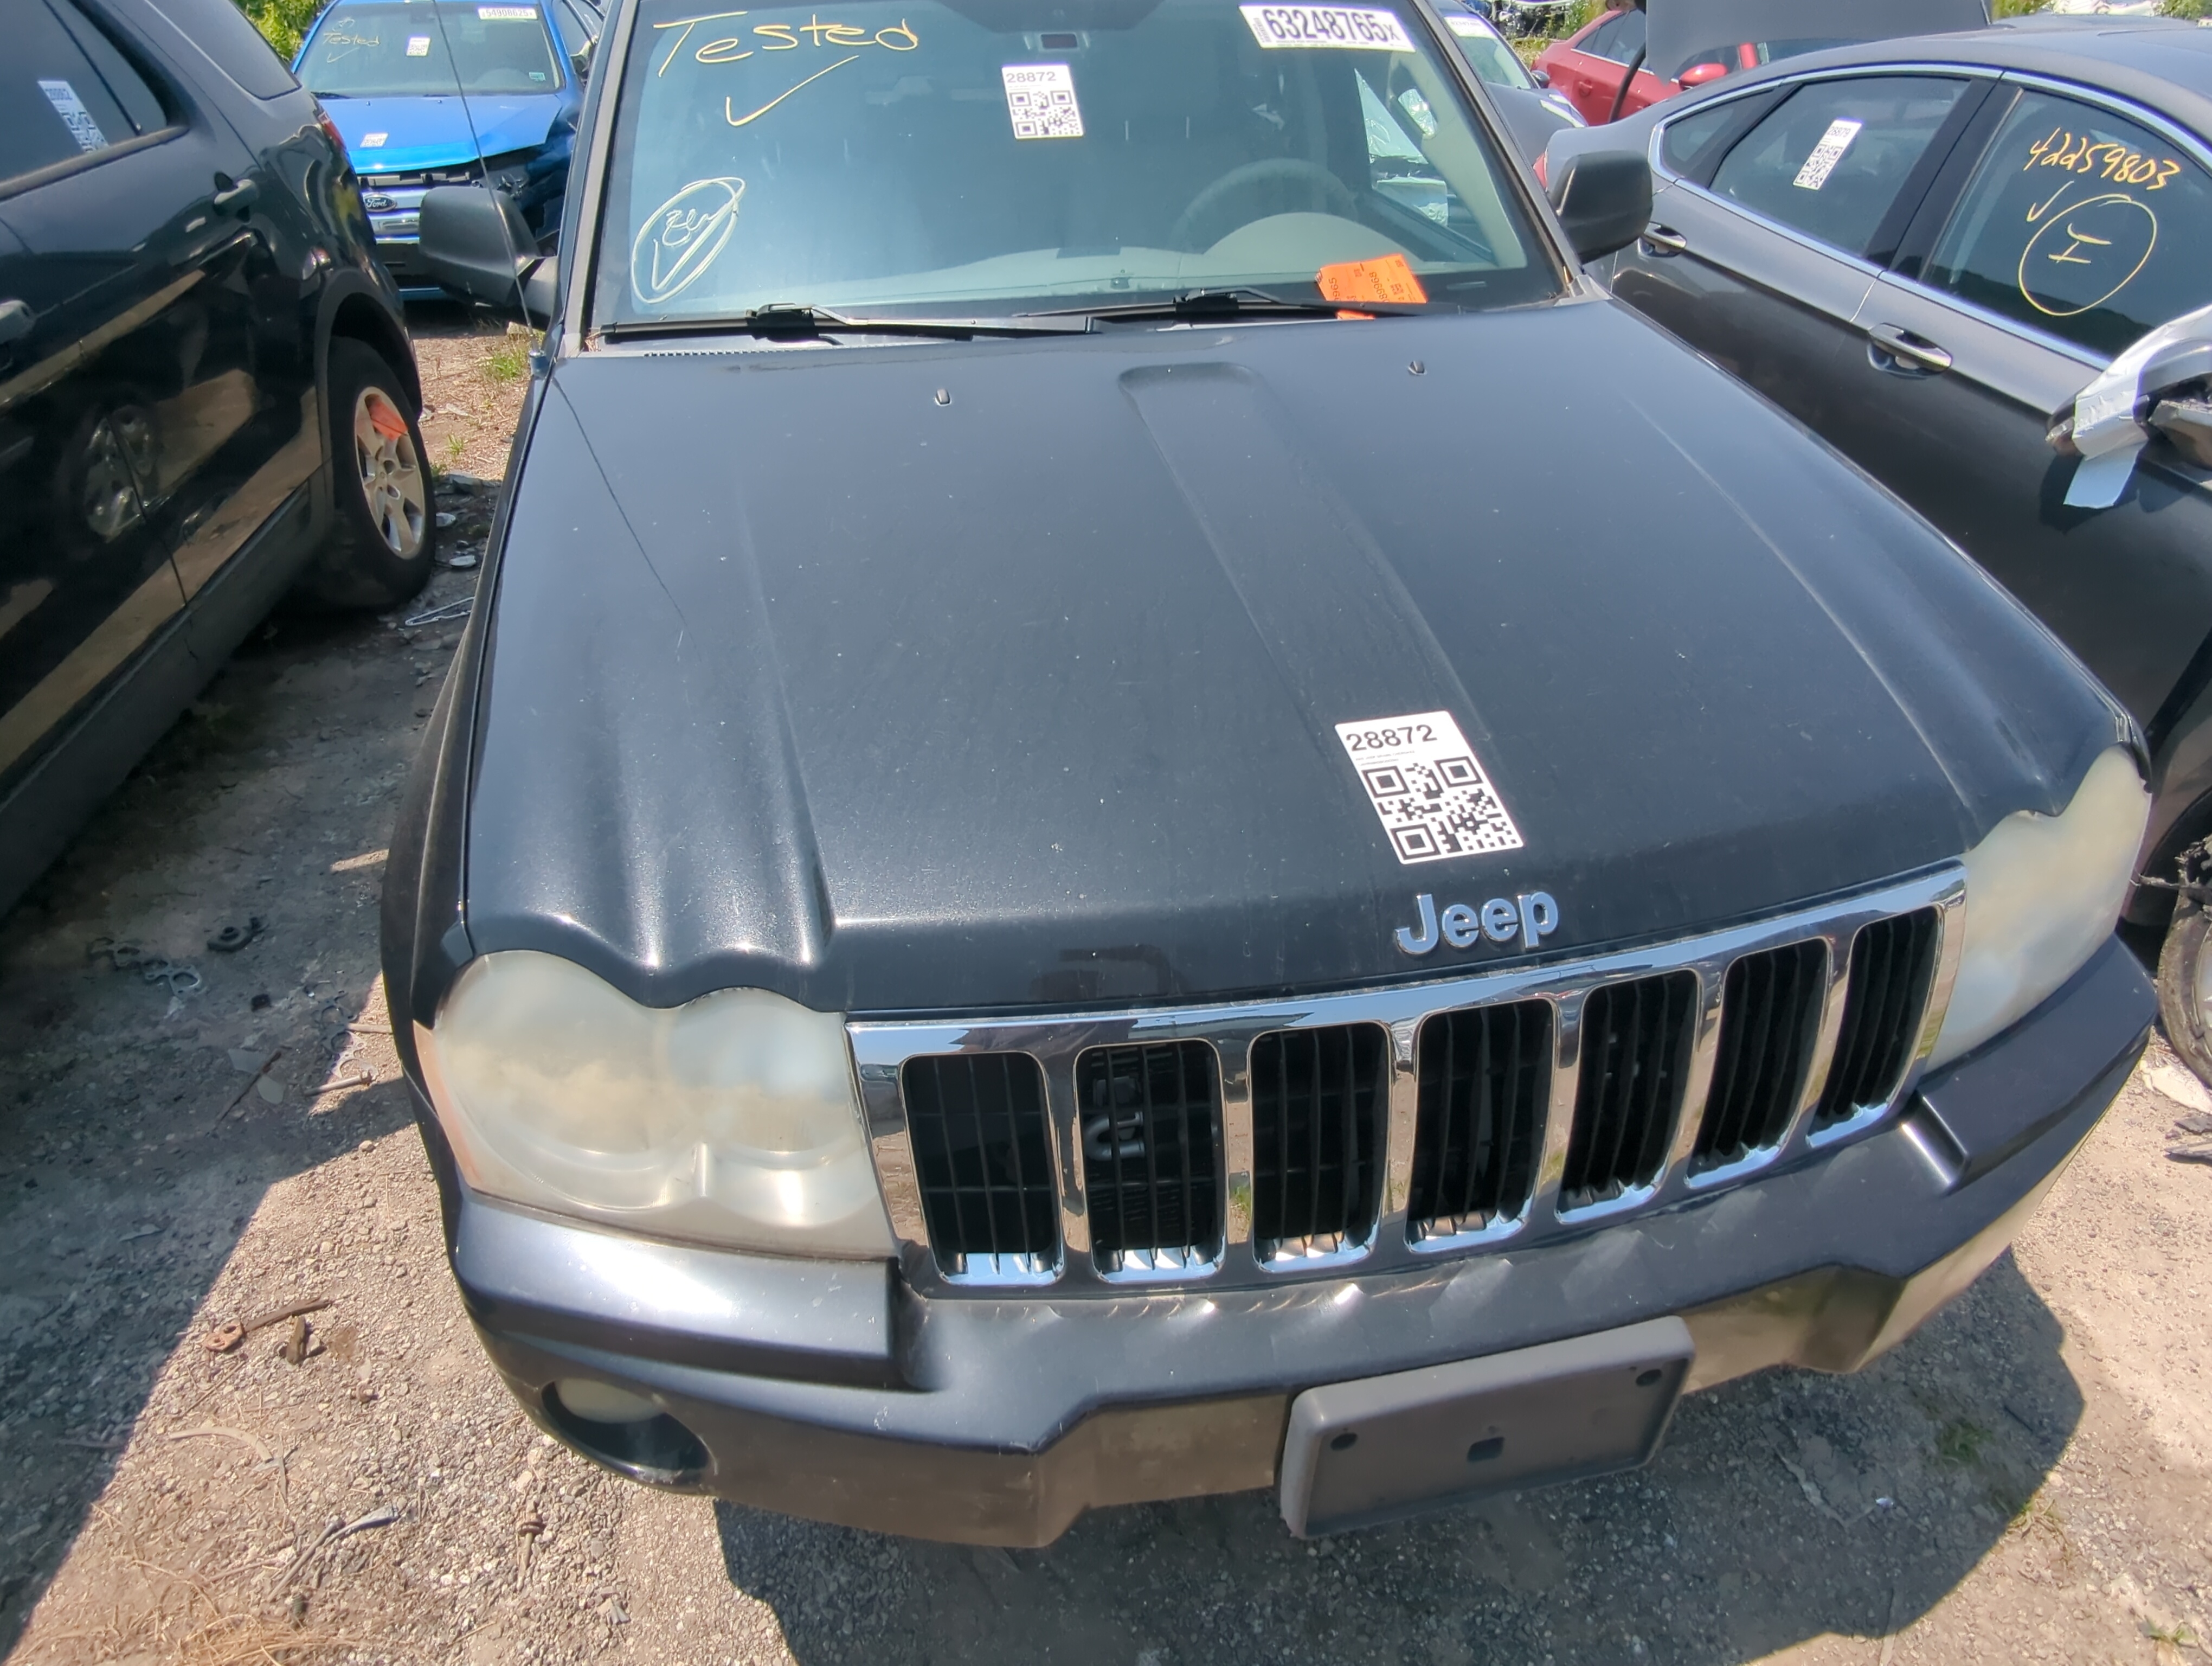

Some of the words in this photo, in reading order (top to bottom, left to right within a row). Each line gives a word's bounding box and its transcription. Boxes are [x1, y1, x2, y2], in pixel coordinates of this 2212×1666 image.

[322, 32, 381, 47] Tested
[653, 11, 919, 78] Tested
[1006, 71, 1057, 83] 28872
[366, 198, 387, 208] Ford
[1346, 724, 1438, 752] 28872
[1395, 890, 1559, 955] Jeep
